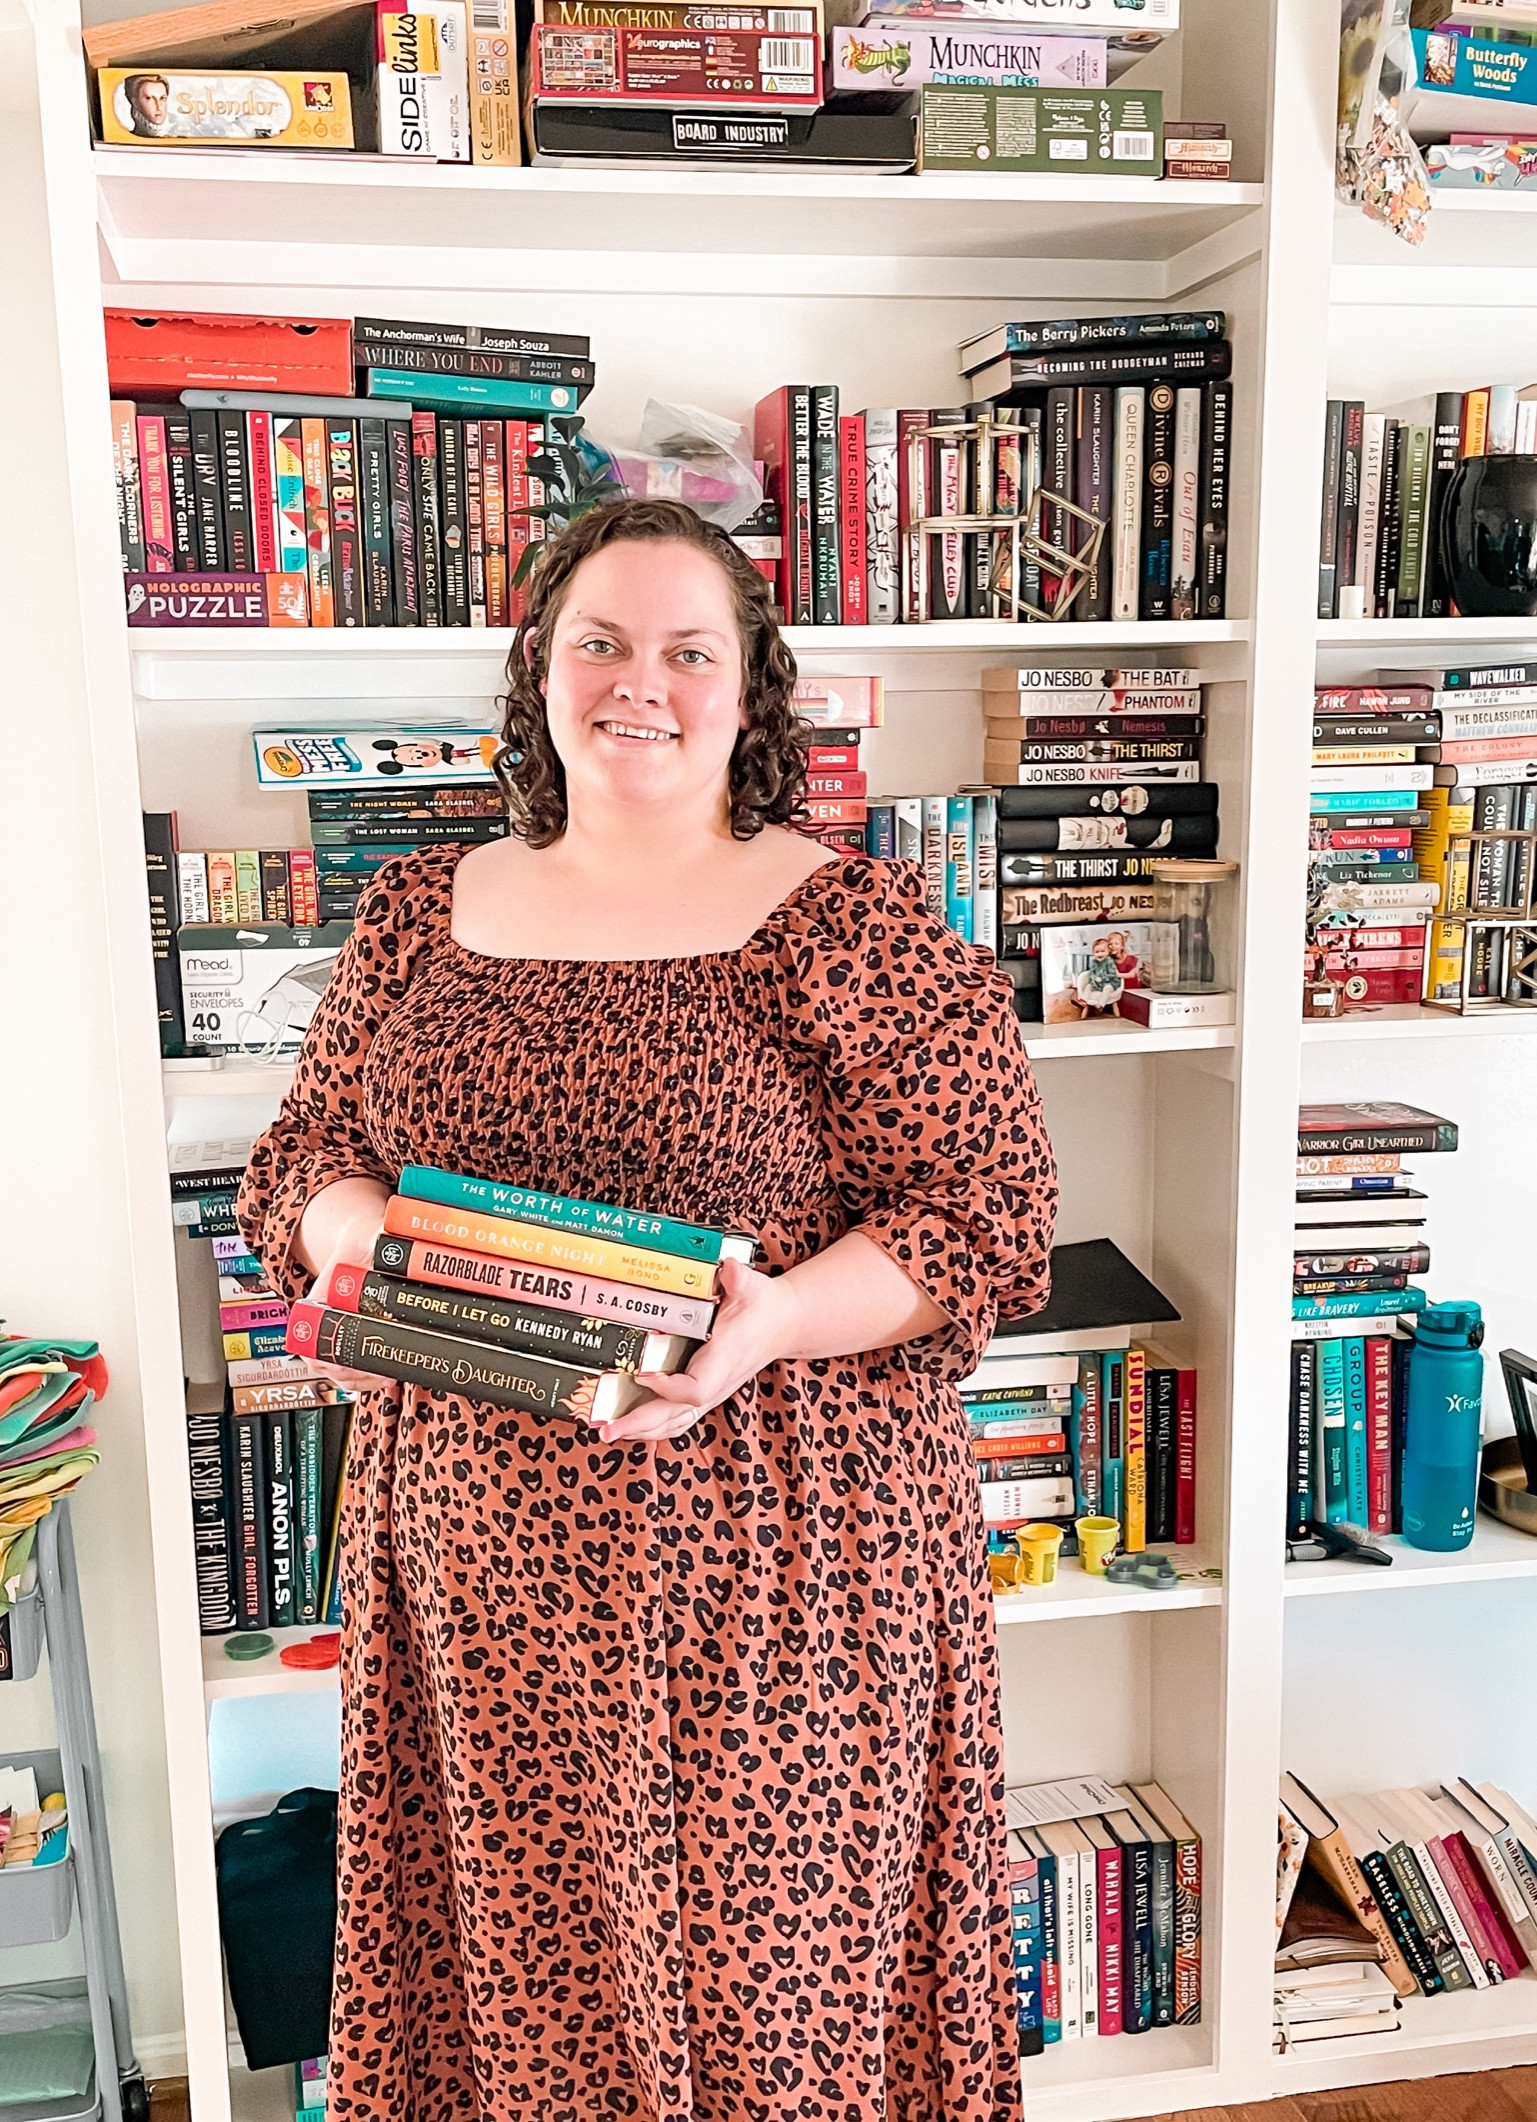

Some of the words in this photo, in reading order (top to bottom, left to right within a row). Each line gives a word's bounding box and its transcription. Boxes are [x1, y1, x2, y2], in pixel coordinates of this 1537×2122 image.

[392, 13, 418, 73] links
[929, 36, 1041, 76] MUNCHKIN
[1466, 47, 1528, 70] Butterfly
[1473, 64, 1517, 83] Woods
[176, 90, 283, 126] Splendor
[400, 77, 422, 152] SIDE
[677, 122, 718, 141] BOARD
[724, 125, 785, 143] INDUSTRY
[364, 327, 381, 338] The
[383, 329, 443, 343] Anchorman's
[443, 334, 465, 345] Wife
[482, 336, 518, 350] Joseph
[520, 342, 550, 351] Souza
[1015, 328, 1038, 343] The
[1042, 328, 1078, 342] Berry
[1081, 324, 1127, 339] Pickers
[363, 347, 425, 367] WHERE
[431, 352, 463, 370] YOU
[470, 356, 503, 374] END
[530, 361, 562, 370] ABBOTT
[530, 370, 562, 378] KAHLER
[795, 394, 809, 442] BETTER
[817, 396, 835, 438] WADE
[1056, 403, 1068, 424] the
[1092, 393, 1101, 424] KARIN
[1214, 394, 1226, 442] BEHIND
[145, 425, 159, 453] THANK
[1127, 403, 1138, 449] QUEEN
[1436, 437, 1460, 446] FORGET
[1438, 426, 1460, 435] DON'T
[256, 432, 266, 473] BEHIND
[796, 445, 809, 461] THE
[821, 444, 832, 456] IN
[848, 424, 857, 463] TRUE
[1056, 429, 1068, 489] collective
[1092, 428, 1101, 486] SLAUGHTER
[1369, 440, 1377, 478] TASTE
[1442, 449, 1453, 458] US
[147, 456, 160, 473] YOU
[224, 430, 244, 511] BLOODLINE
[370, 451, 380, 497] PRETTY
[421, 457, 433, 493] ONLY
[822, 458, 832, 470] THE
[1213, 448, 1224, 473] HER
[1437, 460, 1455, 470] HERE
[149, 476, 162, 493] FOR
[173, 456, 186, 507] SILENT
[797, 464, 810, 499] BLOOD
[848, 469, 857, 514] CRIME
[1124, 454, 1136, 531] CHARLOTTE
[1212, 478, 1223, 509] EYES
[258, 478, 269, 520] CLOSED
[423, 496, 434, 521] SHE
[818, 475, 835, 526] WATER
[1091, 495, 1099, 513] THE
[150, 496, 165, 539] LISTENING
[177, 513, 189, 552] GIRLS
[372, 502, 383, 539] GIRLS
[1364, 500, 1375, 548] POISON
[260, 525, 271, 561] DOORS
[424, 526, 434, 560] CAME
[849, 518, 859, 567] STORY
[147, 583, 262, 593] HOLOGRAPHIC
[425, 564, 436, 596] BACK
[151, 597, 263, 618] PUZZLE
[1121, 671, 1150, 686] THE
[1153, 670, 1180, 686] BAT
[1469, 668, 1526, 685] WAVEWALKER
[1124, 696, 1185, 708] PHANTOM
[1122, 720, 1166, 732] Nemesis
[1335, 727, 1356, 735] DAVE
[1357, 726, 1388, 734] CULLEN
[1113, 745, 1139, 759] THE
[1140, 743, 1184, 758] THIRST
[1089, 767, 1123, 780] KNIFE
[979, 834, 995, 842] THE
[193, 873, 202, 888] THE
[979, 845, 995, 891] MIST
[1055, 860, 1078, 878] THE
[1079, 859, 1119, 877] THIRST
[1122, 858, 1138, 876] JO
[195, 893, 204, 912] GIRL
[1014, 896, 1037, 916] The
[1040, 892, 1104, 913] Redbreast
[1108, 896, 1125, 910] JO
[187, 958, 229, 971] mead
[190, 998, 244, 1008] ENVELOPES
[192, 1013, 221, 1031] 40
[193, 1033, 222, 1041] COUNT
[462, 1183, 486, 1196] THE
[492, 1188, 563, 1214] WORTH
[571, 1206, 589, 1217] OF
[595, 1209, 663, 1236] WATER
[411, 1216, 469, 1238] BLOOD
[476, 1229, 545, 1254] ORANGE
[551, 1246, 606, 1266] NIGHT
[423, 1252, 504, 1286] RAZORBLADE
[509, 1269, 573, 1300] TEARS
[622, 1256, 671, 1273] MELISSA
[627, 1268, 661, 1282] BOND
[396, 1291, 450, 1316] BEFORE
[451, 1305, 458, 1318] I
[461, 1307, 487, 1323] LET
[490, 1313, 511, 1328] GO
[596, 1293, 608, 1306] S.
[610, 1296, 623, 1308] A.
[626, 1299, 669, 1318] COSBY
[260, 1360, 283, 1370] YRSA
[361, 1335, 450, 1374] FIREKEEPER'S
[451, 1359, 546, 1401] DAUGHTER
[1299, 1354, 1311, 1388] CHASE
[1375, 1344, 1389, 1376] THE
[249, 1385, 316, 1404] YRSA
[1087, 1380, 1096, 1408] LITTLE
[1322, 1355, 1344, 1419] CHOSEN
[1350, 1346, 1362, 1412] GROUP
[1375, 1381, 1389, 1412] KEY
[980, 1409, 1027, 1417] ELIZABETH
[1087, 1411, 1096, 1444] HOPE
[1298, 1390, 1310, 1445] DARKNESS
[239, 1426, 251, 1456] KARIN
[1128, 1356, 1144, 1454] SUNDIAL
[1136, 1457, 1147, 1505] CATRIONA
[1375, 1414, 1389, 1451] MAN
[1298, 1451, 1310, 1479] WITH
[240, 1462, 255, 1521] SLAUGHTER
[1087, 1470, 1096, 1502] ETHAN
[1298, 1480, 1309, 1494] ME
[271, 1481, 290, 1551] ANON
[195, 1518, 226, 1550] THE
[197, 1554, 232, 1630] KINGDOM
[244, 1556, 259, 1615] FORGOTTEN
[273, 1558, 291, 1610] PLS.
[1183, 1845, 1197, 1885] HOPE
[1487, 1845, 1507, 1883] WORN
[1503, 1838, 1526, 1878] MIRACLE
[1084, 1883, 1092, 1912] LONG
[1105, 1860, 1118, 1915] WAHALA
[1368, 1858, 1399, 1913] BASELESS
[1182, 1913, 1197, 1960] GLORY
[1105, 1944, 1119, 1981] NIKKI
[1106, 1987, 1119, 2013] MAY
